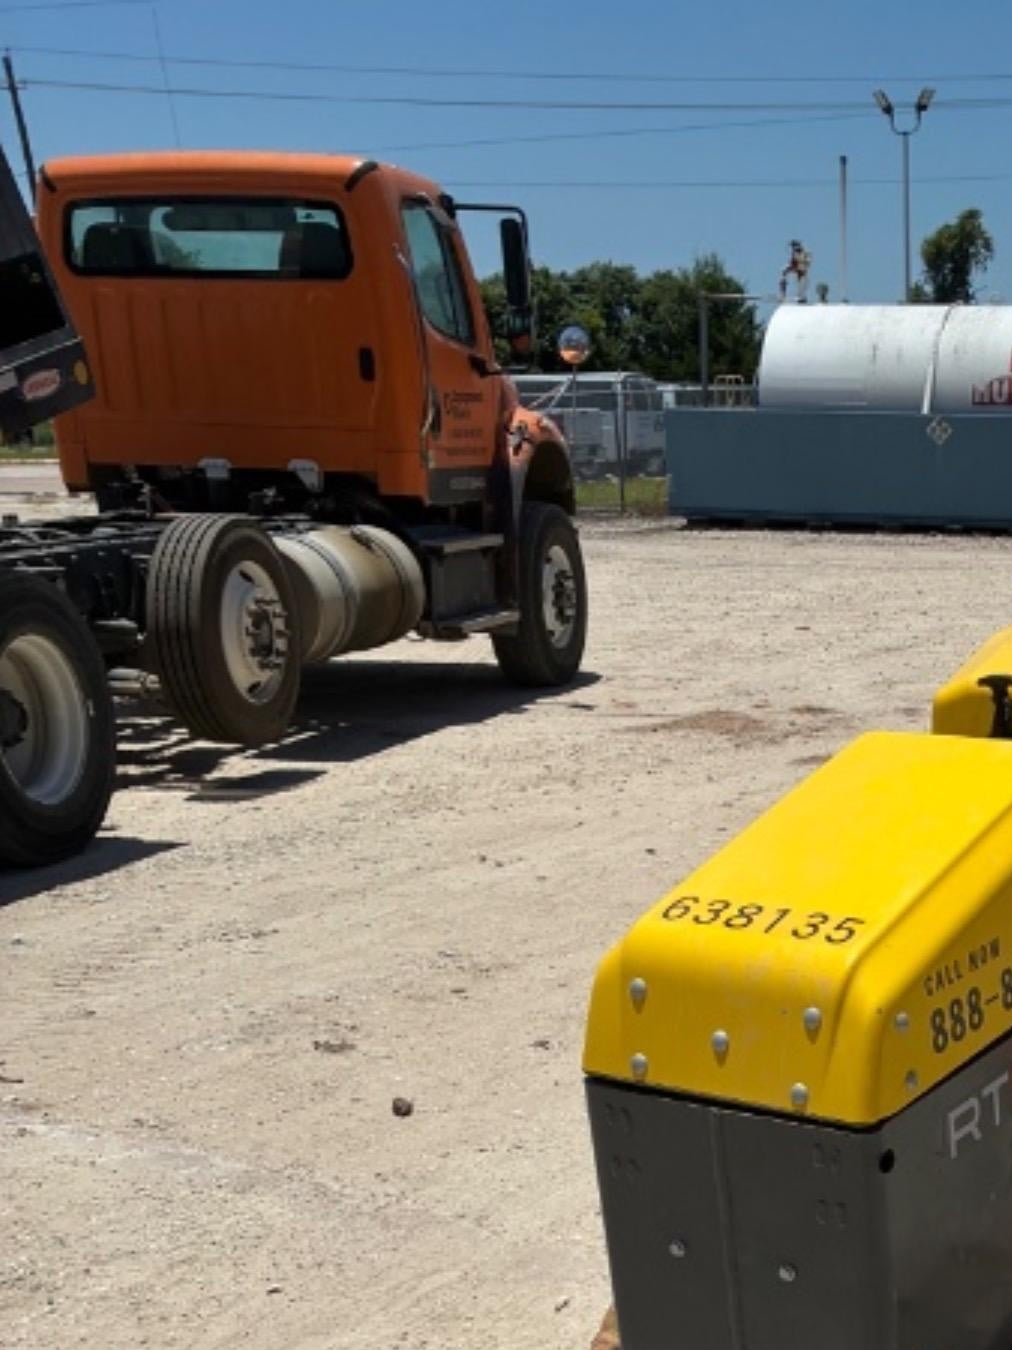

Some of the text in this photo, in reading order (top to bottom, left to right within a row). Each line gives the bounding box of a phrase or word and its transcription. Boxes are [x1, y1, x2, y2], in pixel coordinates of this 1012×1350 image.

[662, 896, 866, 944] 638135
[923, 936, 1001, 996] CALL NOW
